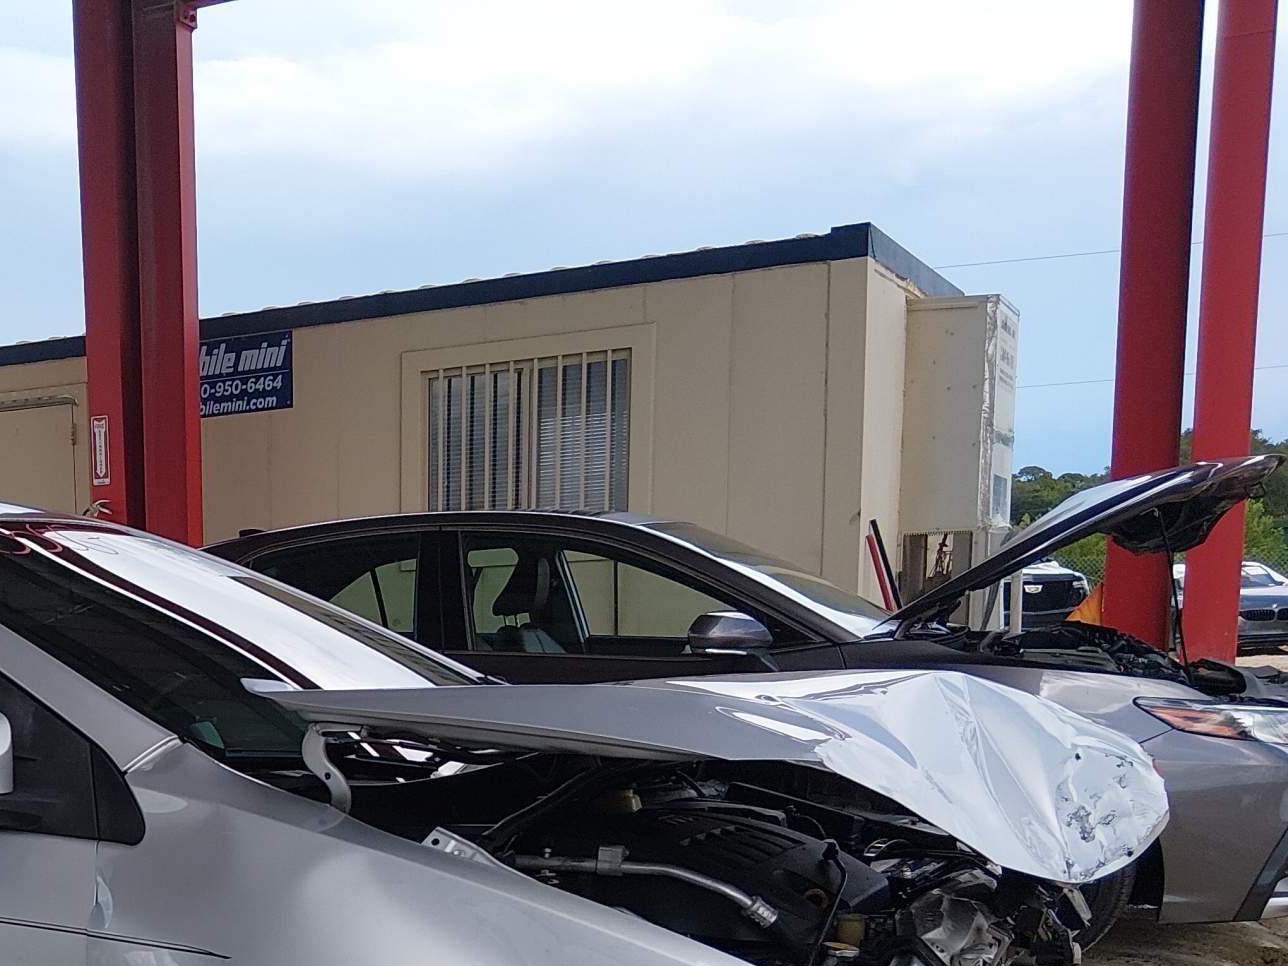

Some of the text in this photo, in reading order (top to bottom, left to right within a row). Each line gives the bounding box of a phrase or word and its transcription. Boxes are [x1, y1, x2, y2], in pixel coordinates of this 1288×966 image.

[199, 339, 288, 377] bile mini
[200, 374, 283, 398] 0-950-6464
